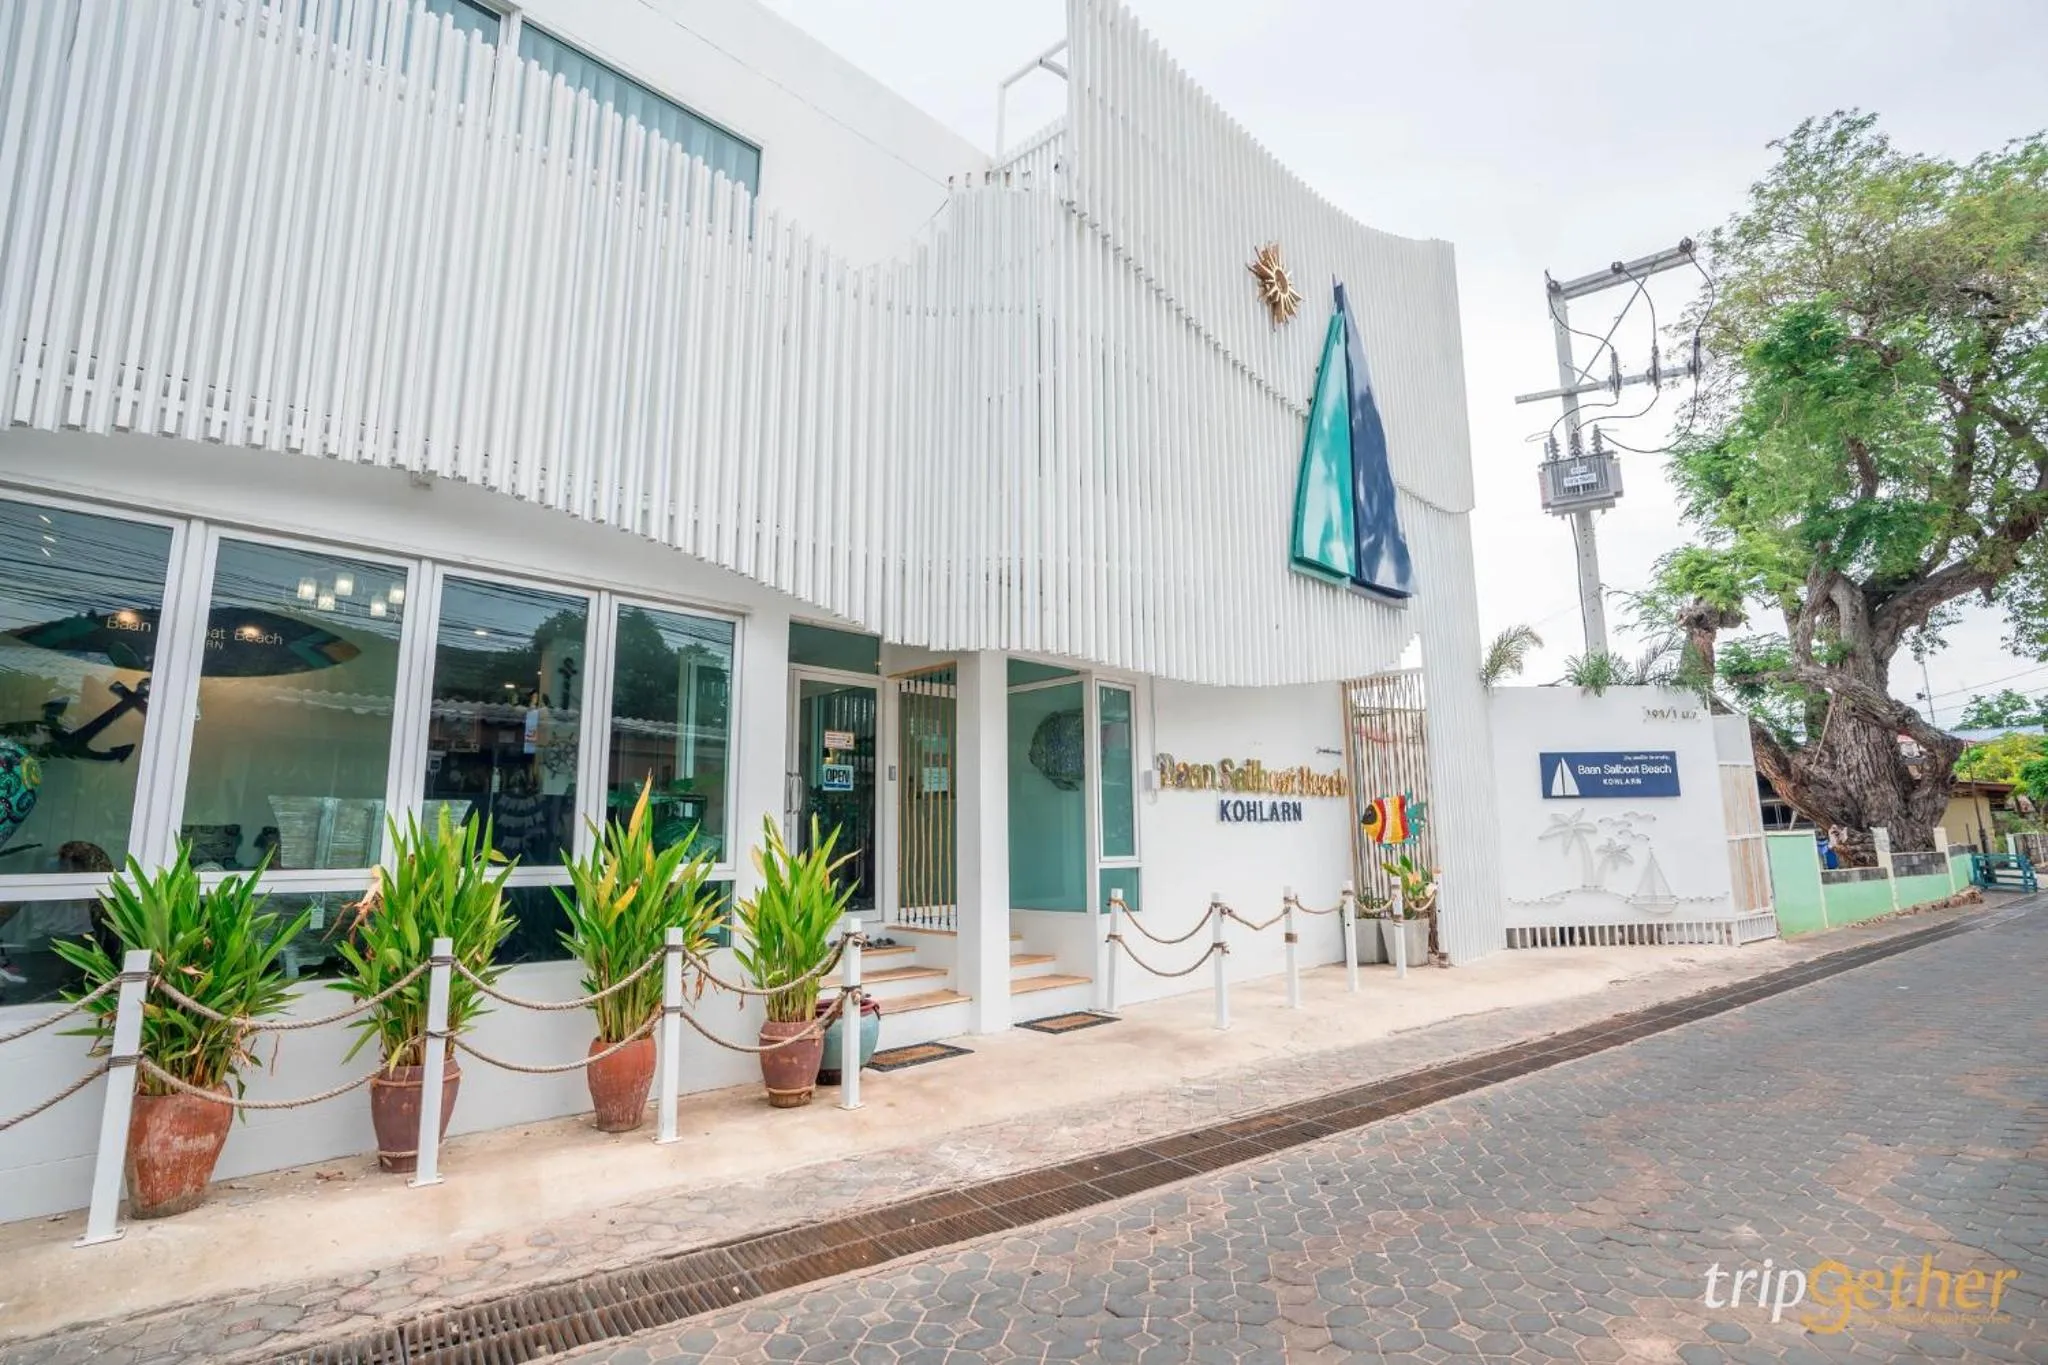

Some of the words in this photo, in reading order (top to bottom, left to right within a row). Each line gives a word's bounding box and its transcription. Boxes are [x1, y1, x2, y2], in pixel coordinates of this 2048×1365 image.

[106, 616, 152, 633] Baan
[234, 628, 283, 645] Beach
[825, 768, 850, 783] OPEN
[1577, 765, 1601, 775] Baan
[1603, 764, 1639, 775] Sailboat
[1641, 763, 1672, 775] Beach
[1220, 799, 1303, 822] KOHLARN
